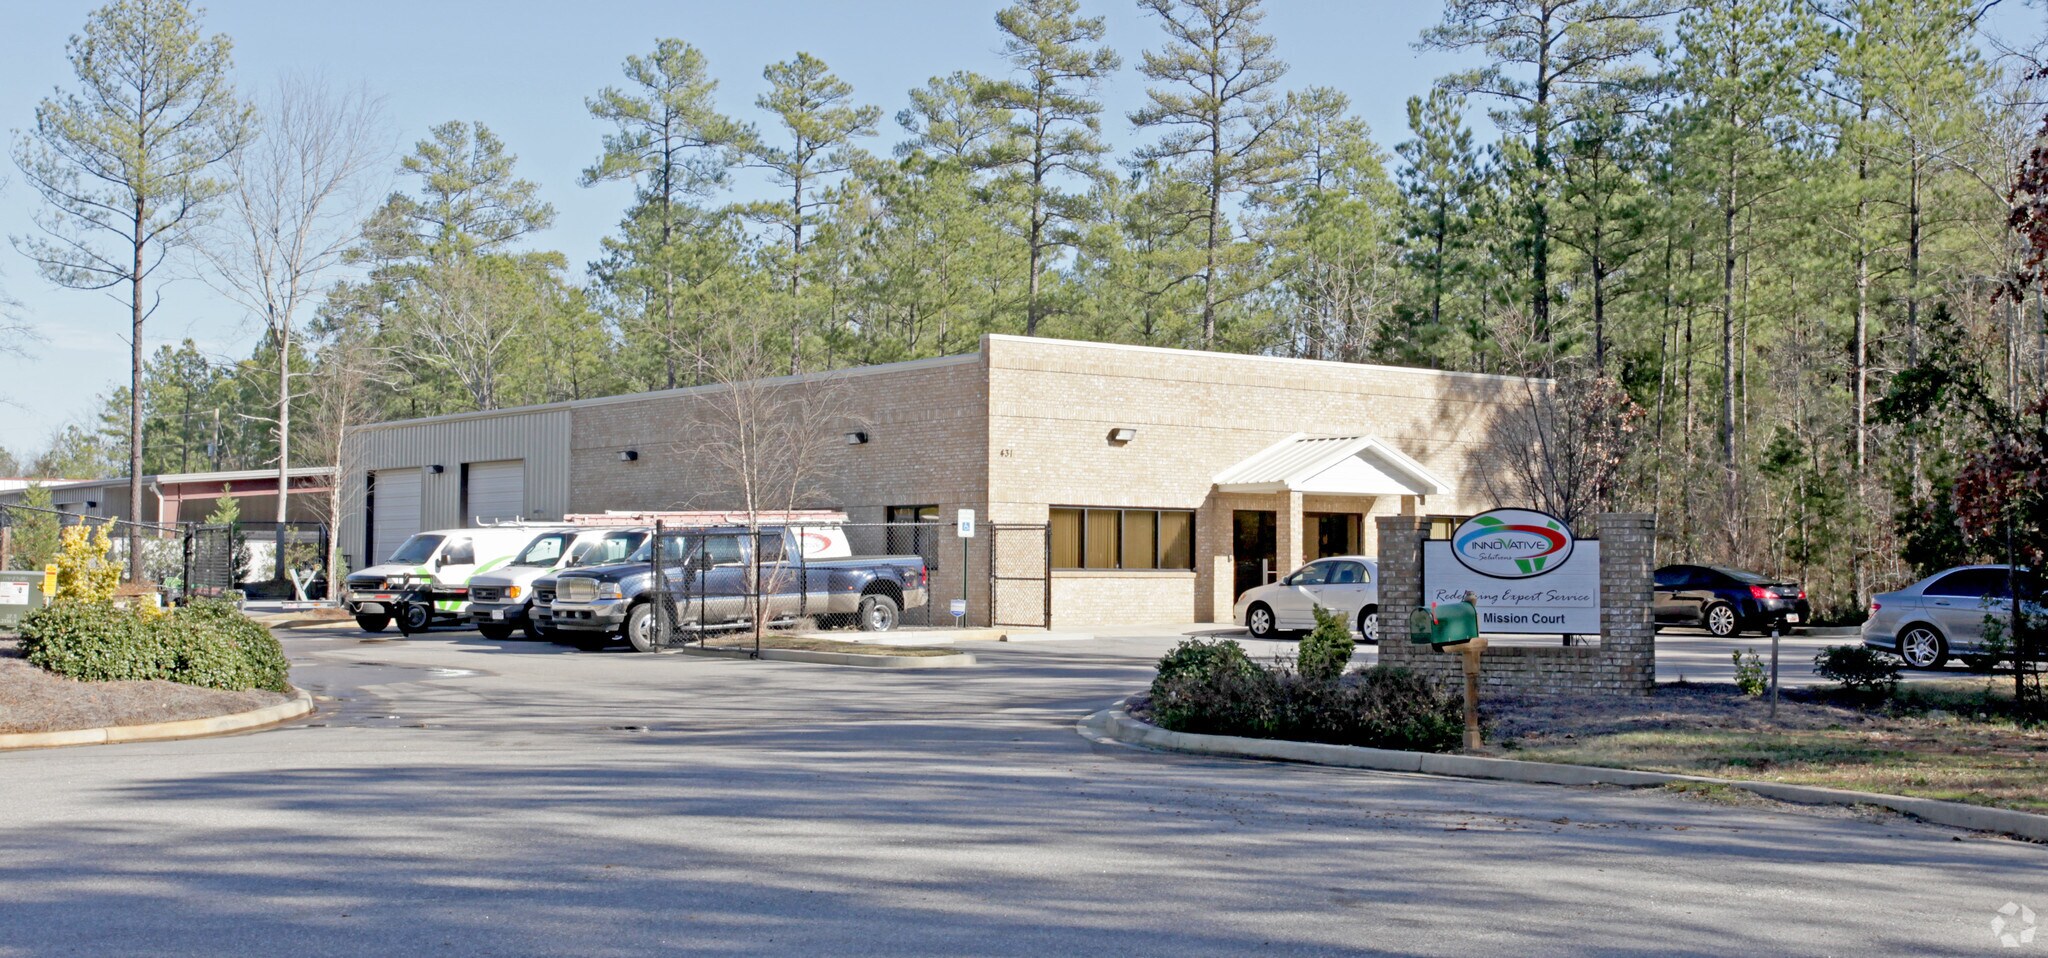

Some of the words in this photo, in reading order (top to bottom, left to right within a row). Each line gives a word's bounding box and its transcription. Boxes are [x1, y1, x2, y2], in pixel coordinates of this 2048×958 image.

[1000, 449, 1013, 458] 431
[1472, 538, 1546, 550] INNOVATIVE
[1479, 552, 1513, 561] Solutions
[1436, 589, 1499, 605] Redefing
[1502, 589, 1543, 605] Expert
[1546, 589, 1590, 602] Service
[1484, 612, 1528, 624] Mission
[1532, 612, 1566, 624] Court
